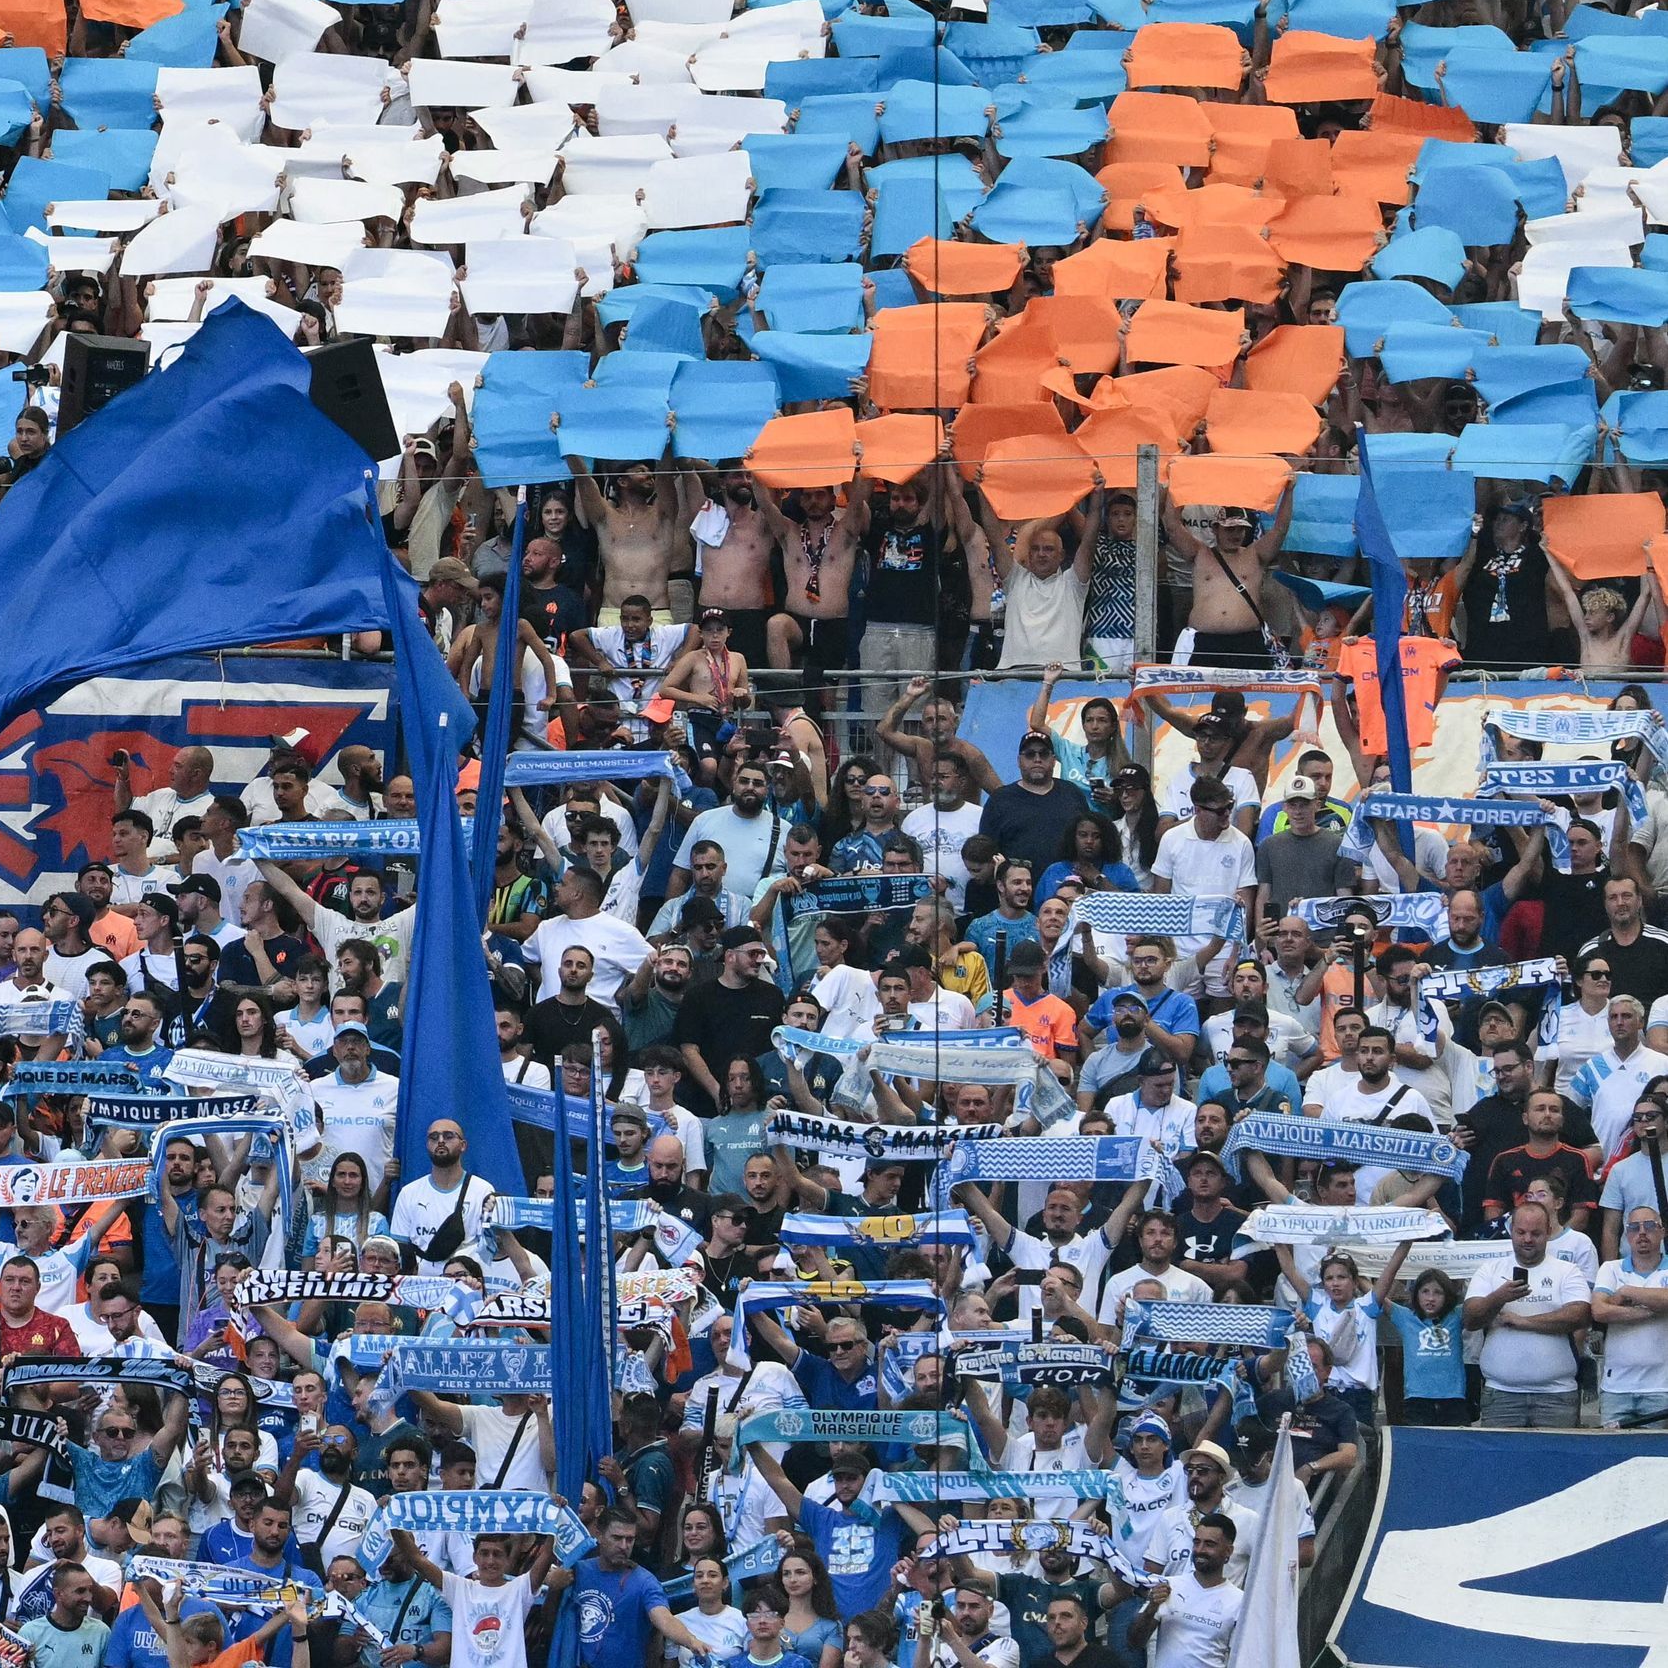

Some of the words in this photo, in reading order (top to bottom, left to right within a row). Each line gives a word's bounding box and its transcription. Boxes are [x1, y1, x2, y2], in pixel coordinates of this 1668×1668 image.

[1370, 804, 1437, 822] STARS
[1457, 807, 1548, 825] FOREVER
[170, 1105, 190, 1119] DE
[1241, 1121, 1324, 1145] LYMPIQUE
[1332, 1131, 1430, 1159] MARSEILLE
[50, 1171, 72, 1196] LE
[403, 1346, 495, 1381] ALLEZ
[438, 1380, 472, 1389] FIERS
[811, 1412, 903, 1426] OLYMPIQUE
[813, 1423, 902, 1438] MARSEILLE
[744, 1549, 774, 1573] 84
